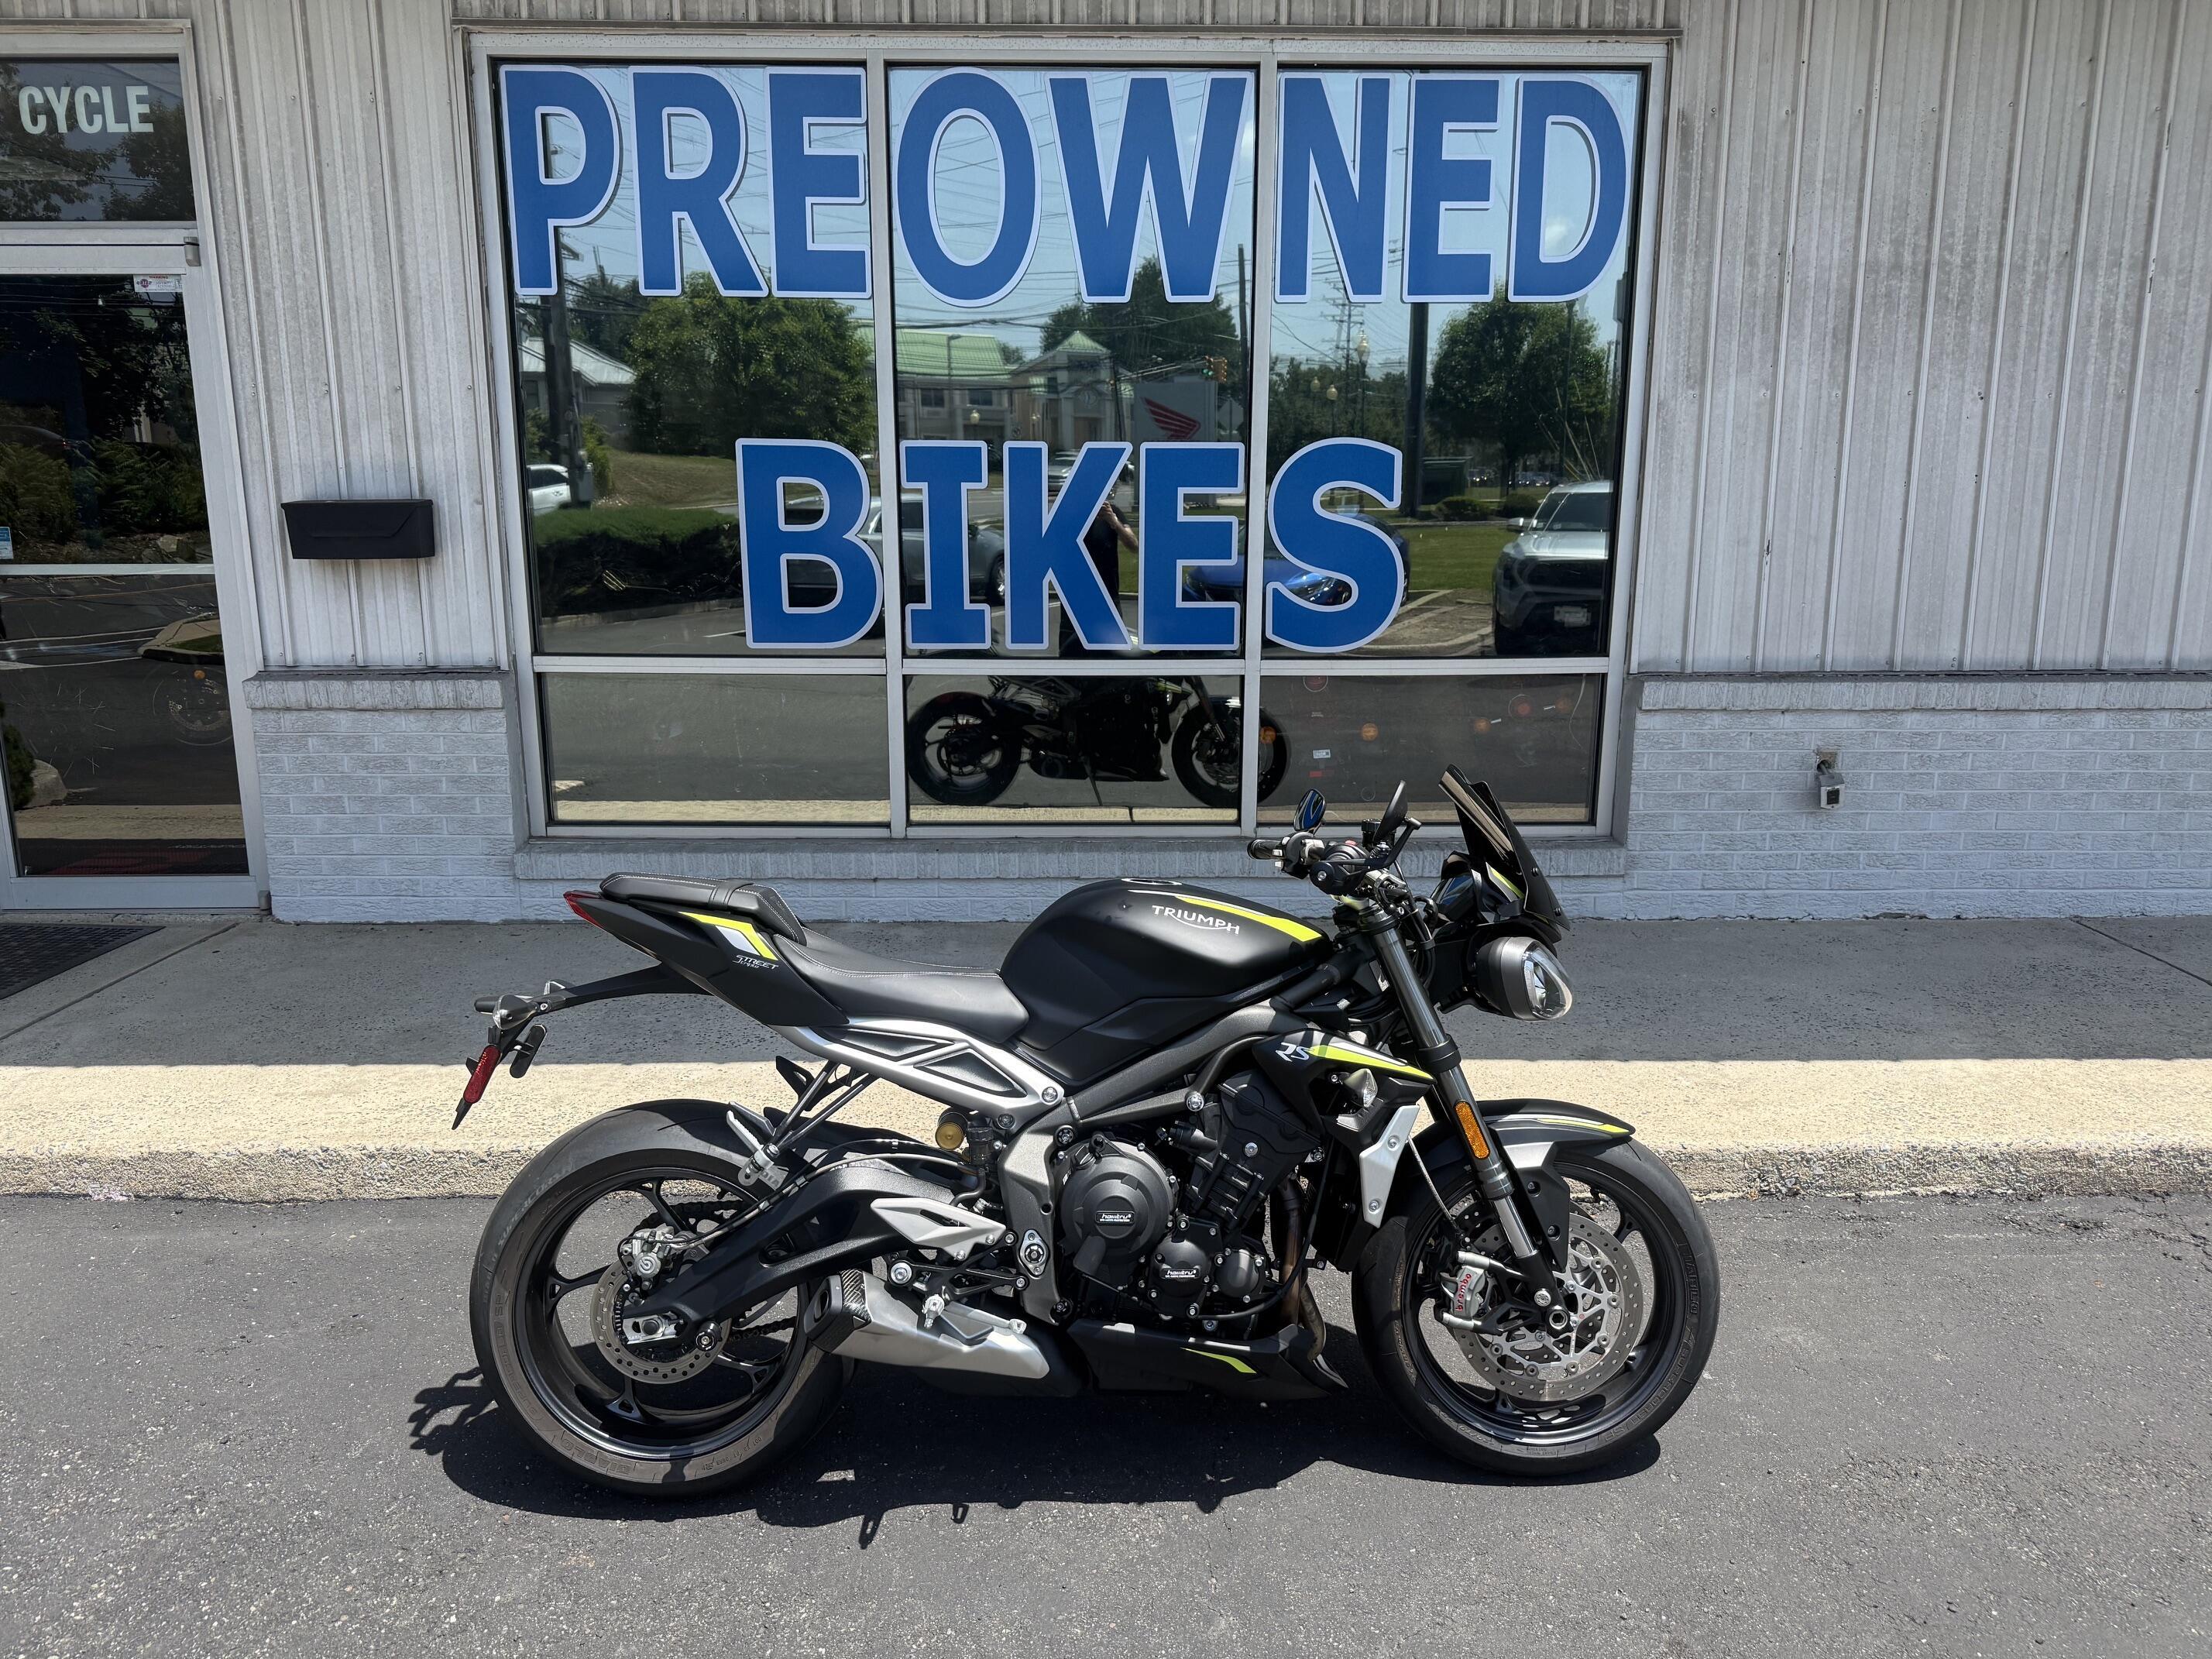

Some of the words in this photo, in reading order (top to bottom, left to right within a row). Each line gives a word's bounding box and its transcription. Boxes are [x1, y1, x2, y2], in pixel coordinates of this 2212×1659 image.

[19, 85, 154, 134] CYCLE
[500, 65, 1630, 307] PREOWNED
[736, 436, 1403, 654] BIKES
[1152, 905, 1240, 935] TRIUMPH
[733, 954, 779, 970] STREET
[1275, 1042, 1310, 1062] RS
[1455, 1273, 1472, 1310] brembo
